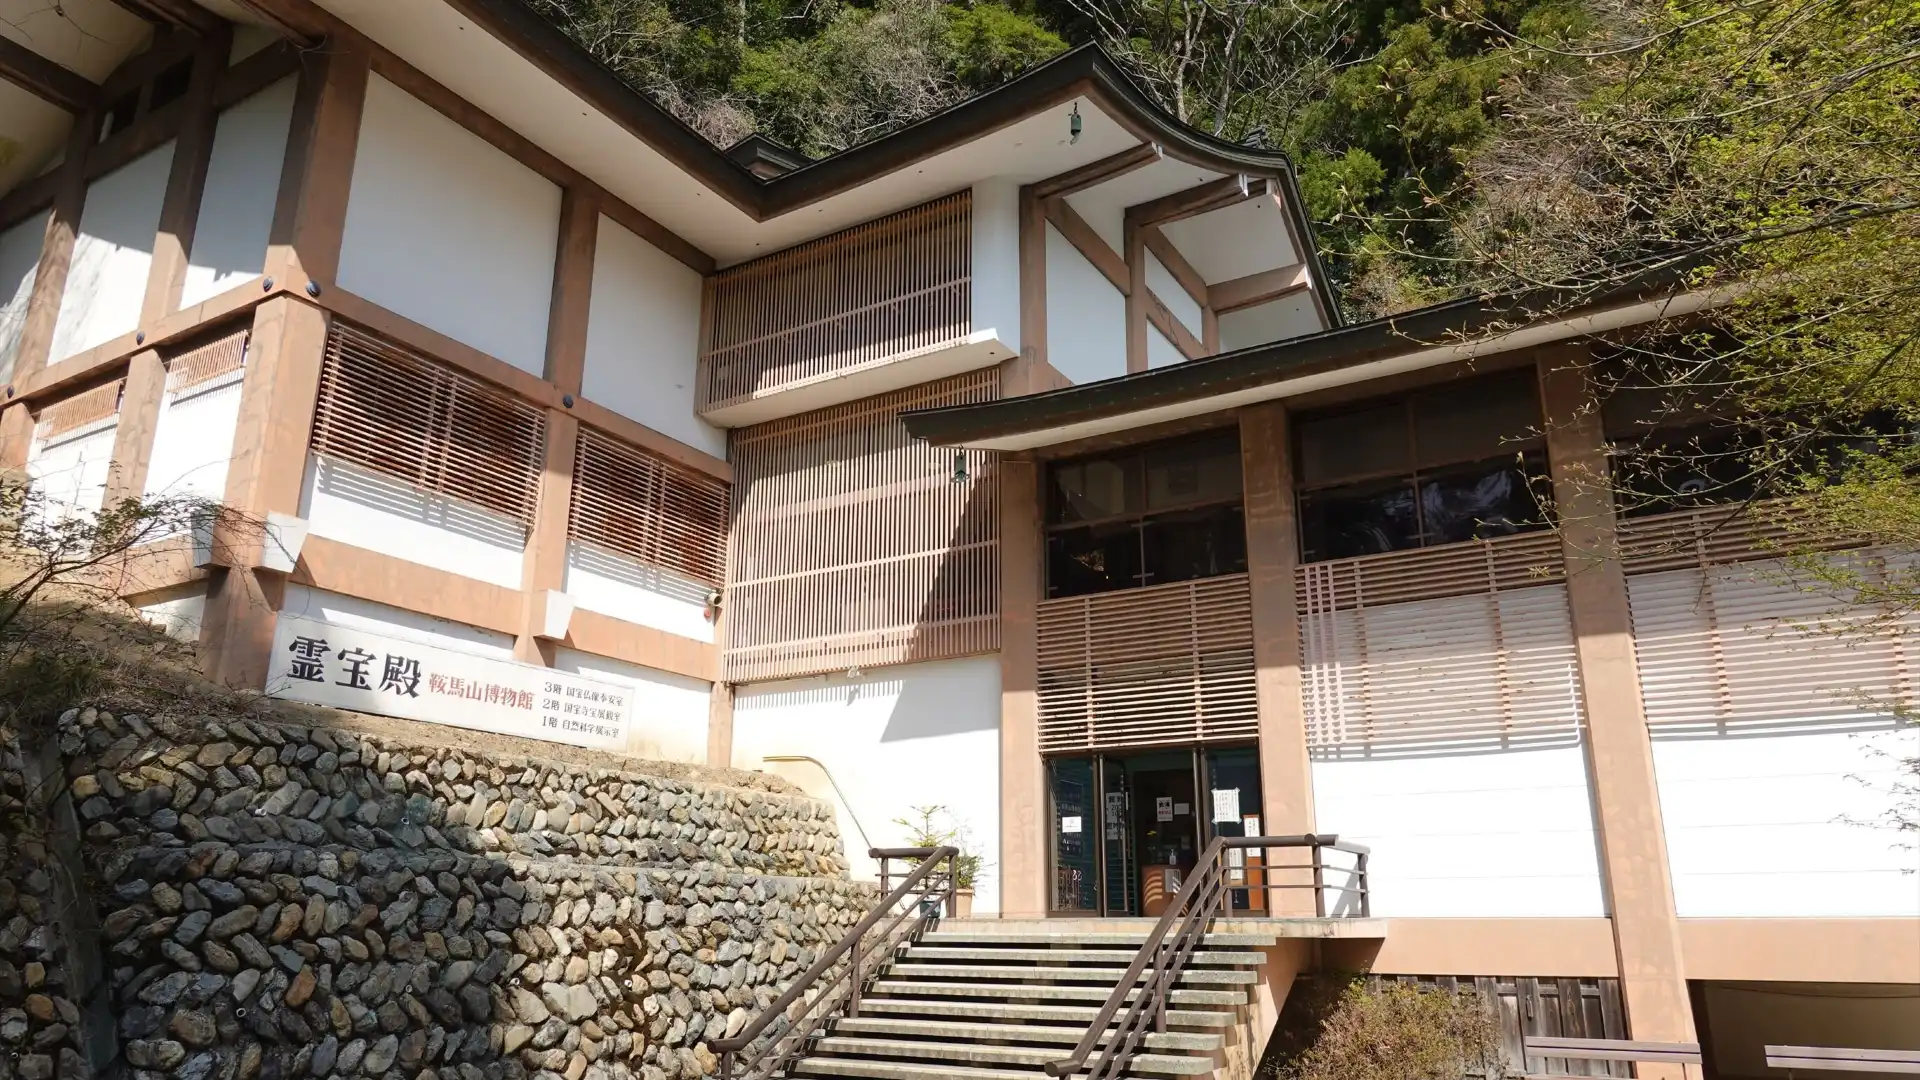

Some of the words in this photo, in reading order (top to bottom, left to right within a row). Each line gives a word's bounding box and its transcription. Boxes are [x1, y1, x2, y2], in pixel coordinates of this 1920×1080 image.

[287, 635, 422, 699] 霊宝殿
[428, 671, 536, 711] 鞍馬山博物館
[544, 682, 562, 694] 3階
[542, 698, 560, 711] 2階
[542, 716, 558, 728] 1階
[562, 719, 619, 738] 自然科学展示室
